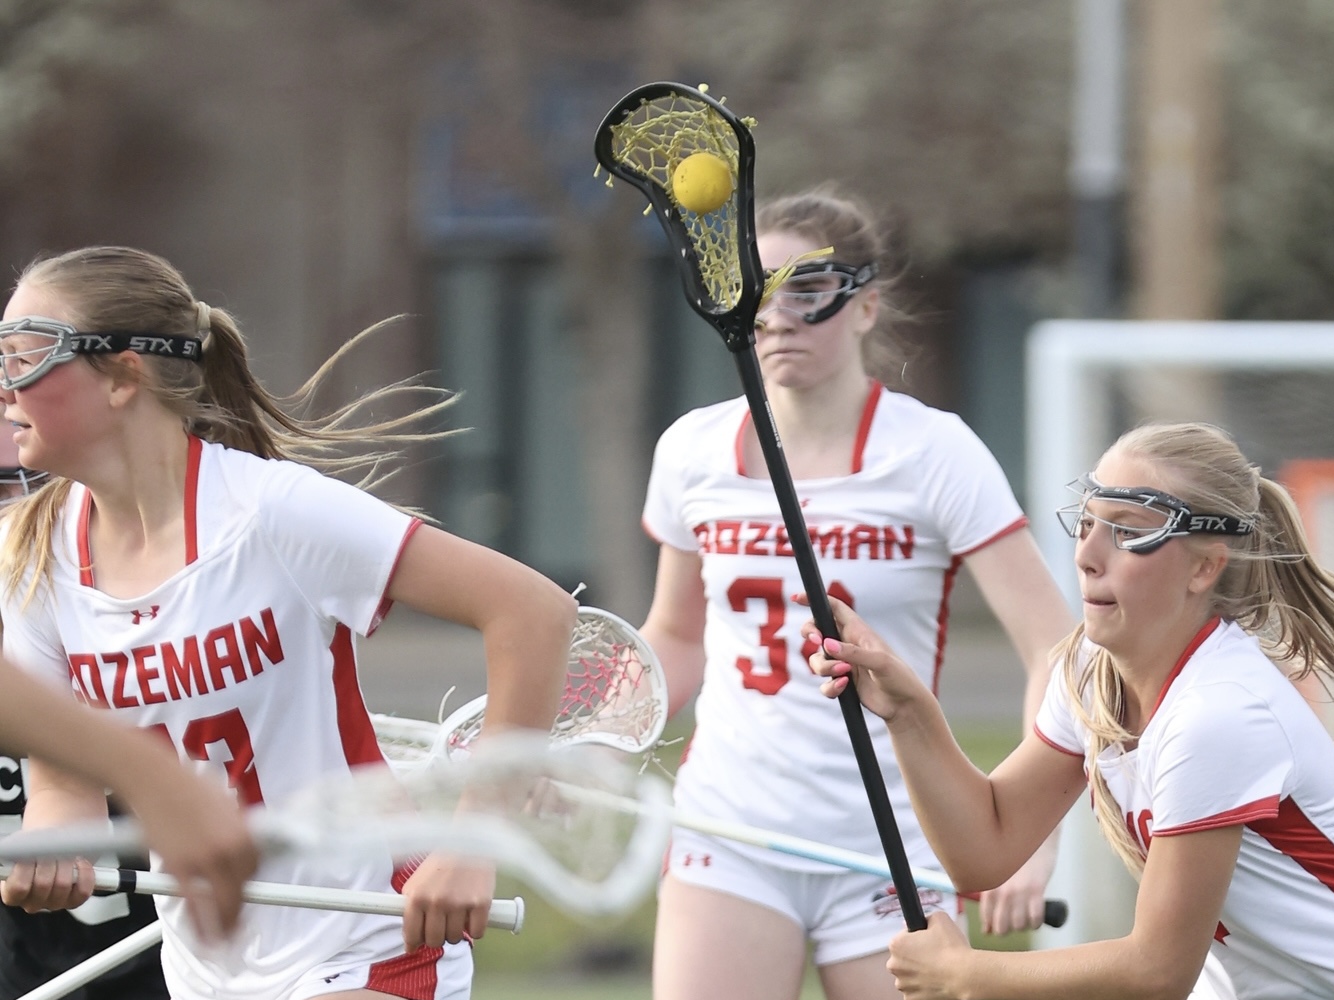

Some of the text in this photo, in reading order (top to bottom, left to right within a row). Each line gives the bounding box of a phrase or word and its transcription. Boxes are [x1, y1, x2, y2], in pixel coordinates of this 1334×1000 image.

[127, 336, 173, 353] STX
[1189, 516, 1228, 530] STX
[68, 607, 285, 709] OZEMAN
[727, 575, 856, 696] 3
